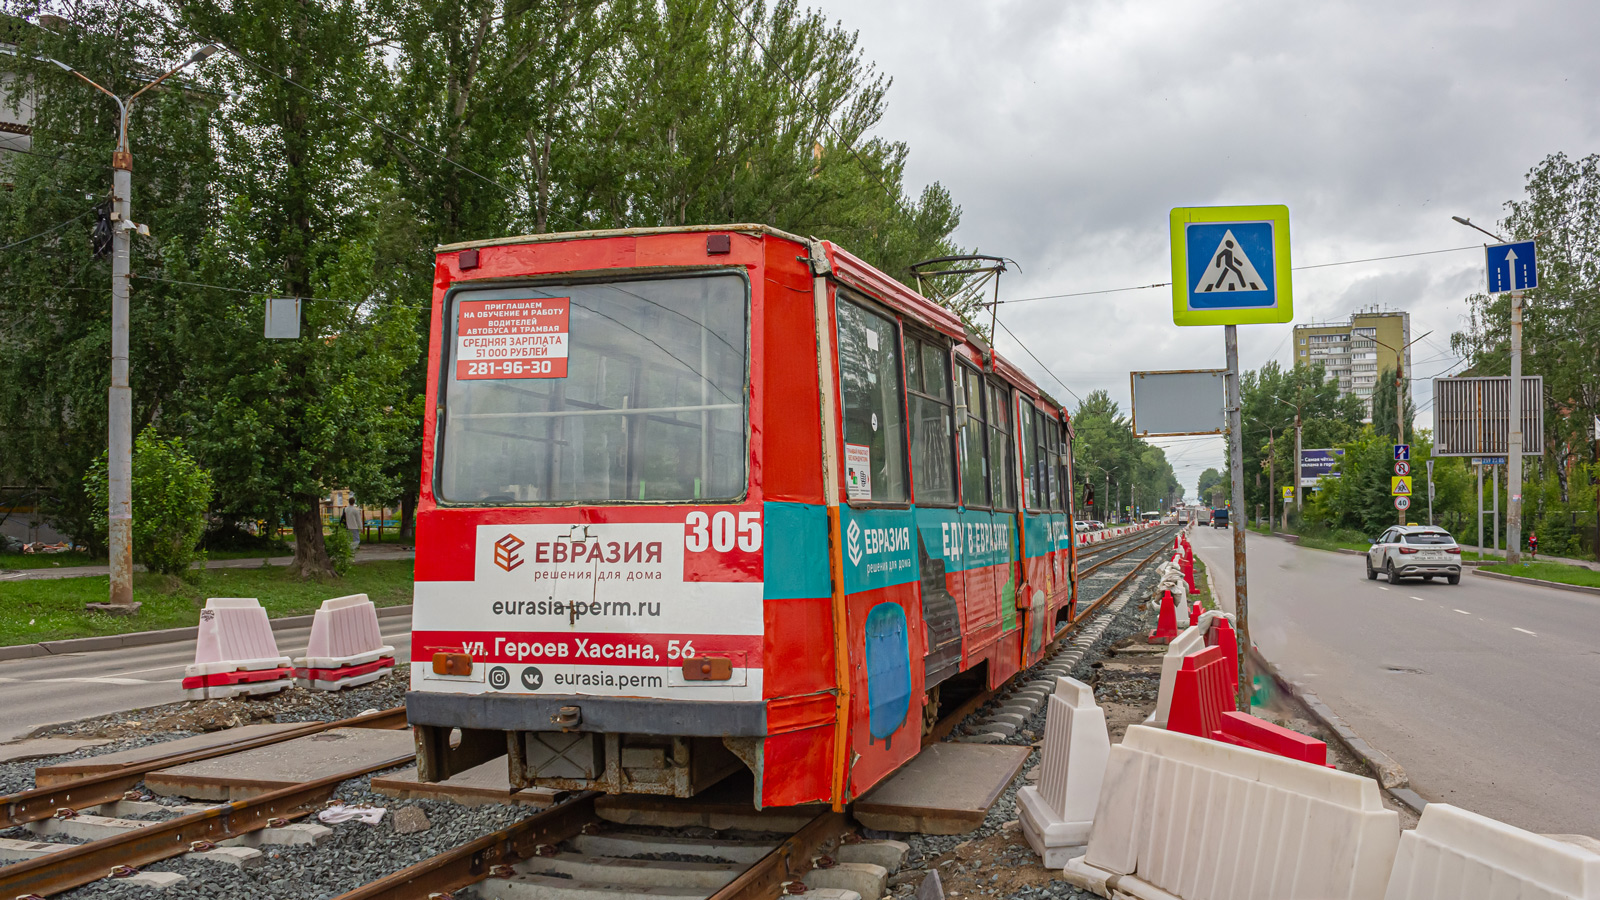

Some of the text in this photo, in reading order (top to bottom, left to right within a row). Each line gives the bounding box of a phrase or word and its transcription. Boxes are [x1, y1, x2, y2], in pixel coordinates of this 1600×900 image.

[477, 310, 520, 318] ОБУЧЕНИЕ
[531, 308, 564, 316] РАБОТУ
[484, 302, 542, 310] ПРИГЛАШАЕМ
[466, 327, 509, 335] АВТОБУСА
[520, 325, 560, 333] ТРАМВАЯ
[488, 318, 538, 327] ВОДИТЕЛЕЙ
[463, 336, 562, 348] СРЕДНЯЯ ЗАРПЛАТА
[476, 345, 548, 358] 51 000 РУБЛЕЙ
[468, 360, 552, 375] 281-96-30
[684, 510, 763, 553] 305
[864, 527, 910, 555] ЕВРАЗИЯ
[941, 522, 1008, 561] ЕДУ В ЕВРАЗИЮ
[535, 541, 662, 564] ЕВРАЗИЯ
[534, 570, 662, 582] решения для дома
[866, 558, 911, 577] решения для дома
[492, 595, 661, 620] eurasia-perm.ru
[462, 637, 696, 662] ул. Героев Хасана, 56
[554, 670, 663, 690] eurasia.perm
